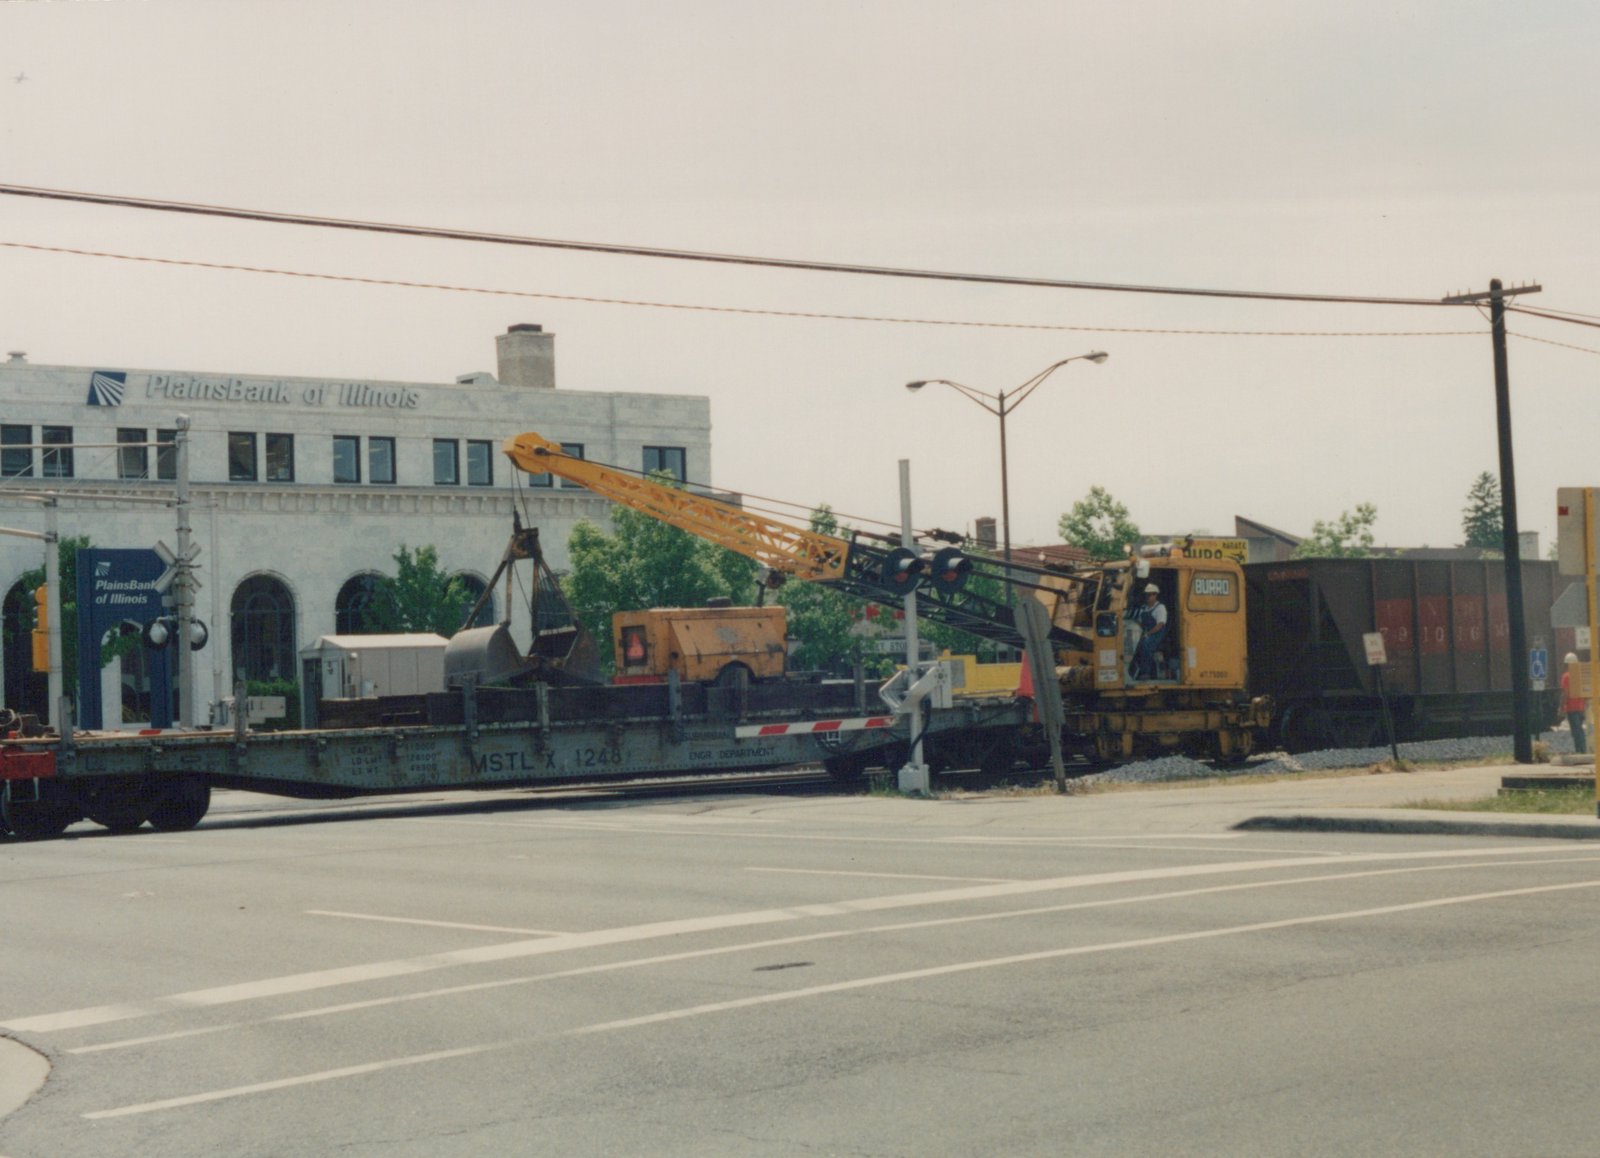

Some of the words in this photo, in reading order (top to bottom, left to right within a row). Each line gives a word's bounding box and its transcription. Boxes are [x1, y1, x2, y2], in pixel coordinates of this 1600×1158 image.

[145, 374, 290, 404] PlainsBank
[303, 384, 326, 406] of
[338, 383, 420, 409] Illinois
[1195, 579, 1229, 595] BURRO
[95, 593, 108, 604] of
[110, 593, 148, 604] Illinois
[470, 751, 534, 774] MSTL
[545, 751, 556, 769] X
[576, 748, 622, 767] 1248
[719, 747, 775, 759] DEPARTMENT
